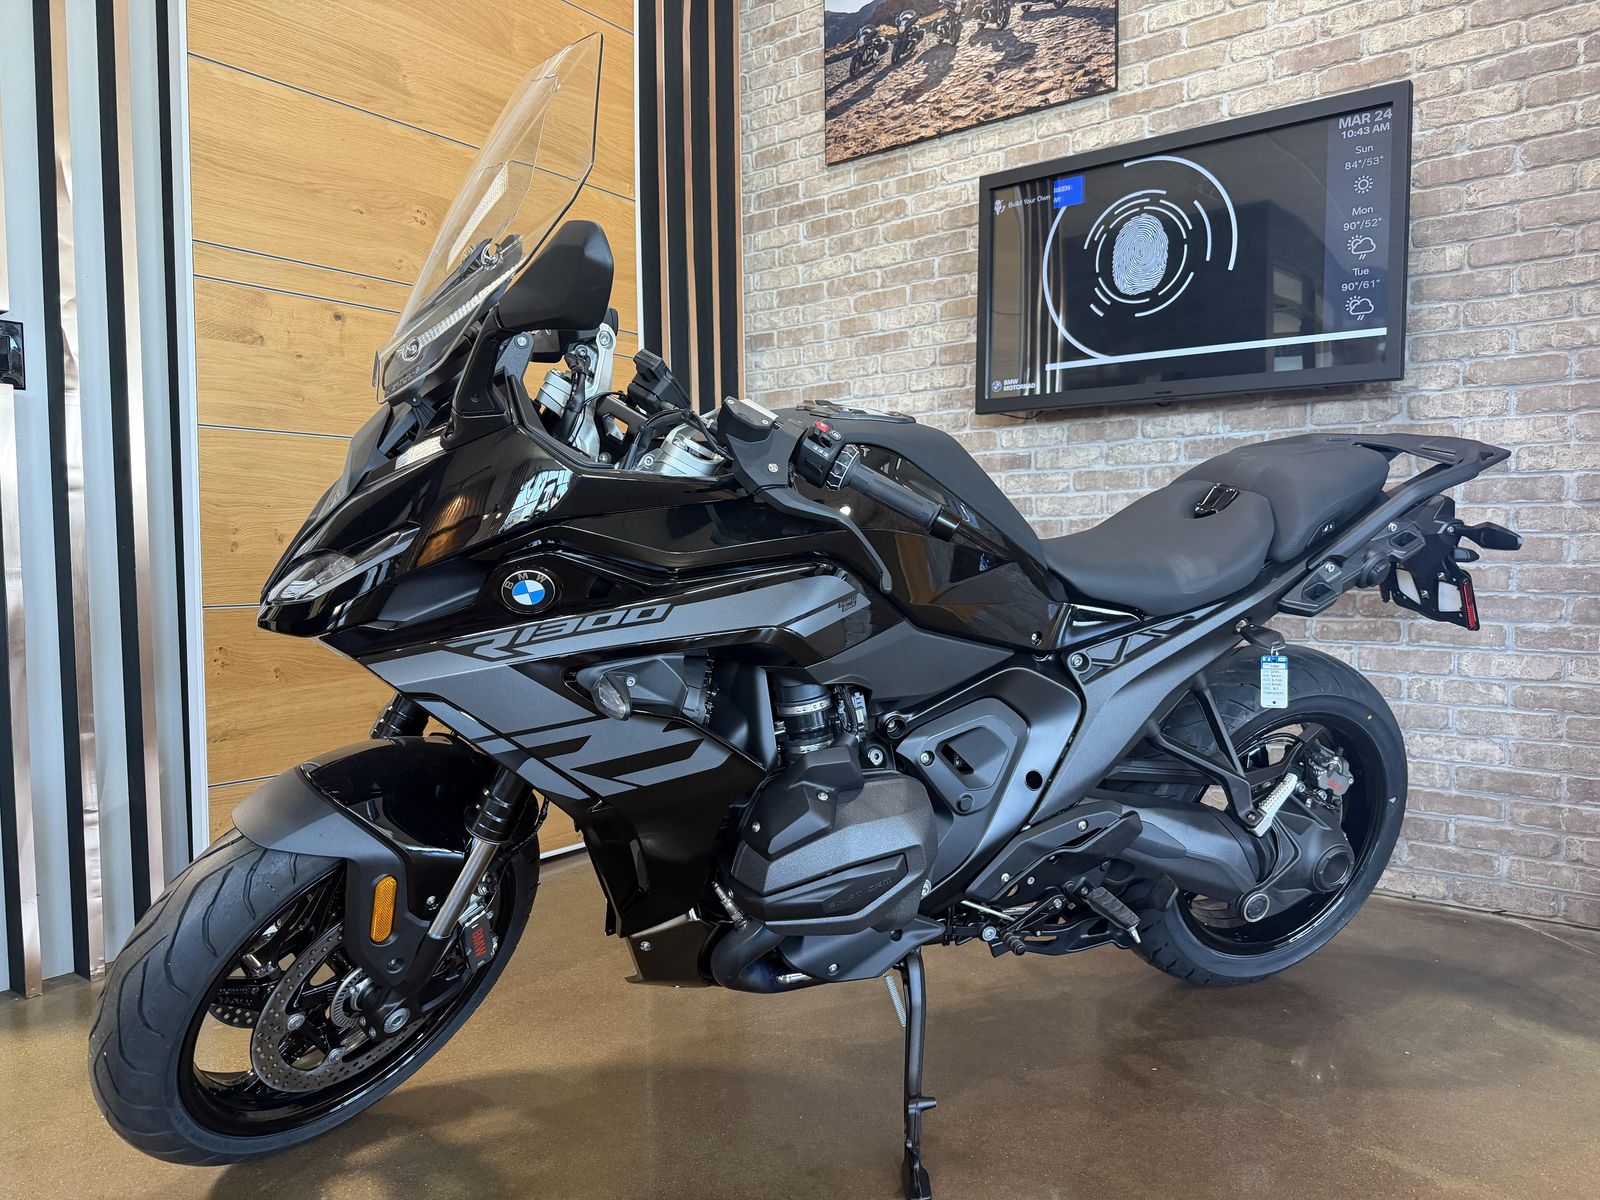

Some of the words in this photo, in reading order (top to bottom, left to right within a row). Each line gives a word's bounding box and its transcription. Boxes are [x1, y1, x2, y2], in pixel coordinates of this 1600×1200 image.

[1338, 112, 1371, 130] MAR
[1376, 107, 1393, 121] 24
[1341, 127, 1370, 139] 10:43
[1372, 122, 1390, 134] AM
[1355, 145, 1374, 154] Sun
[1344, 155, 1384, 170] 84°/53°
[1008, 200, 1022, 208] Build
[1036, 194, 1051, 202] Own
[1352, 206, 1374, 216] Mon
[1343, 217, 1382, 231] 90°/52°
[1353, 267, 1370, 276] Tue
[1341, 279, 1381, 292] 90°/61°
[1004, 383, 1035, 391] MOTORRAD
[504, 572, 547, 590] BMW
[472, 928, 486, 957] BMW
